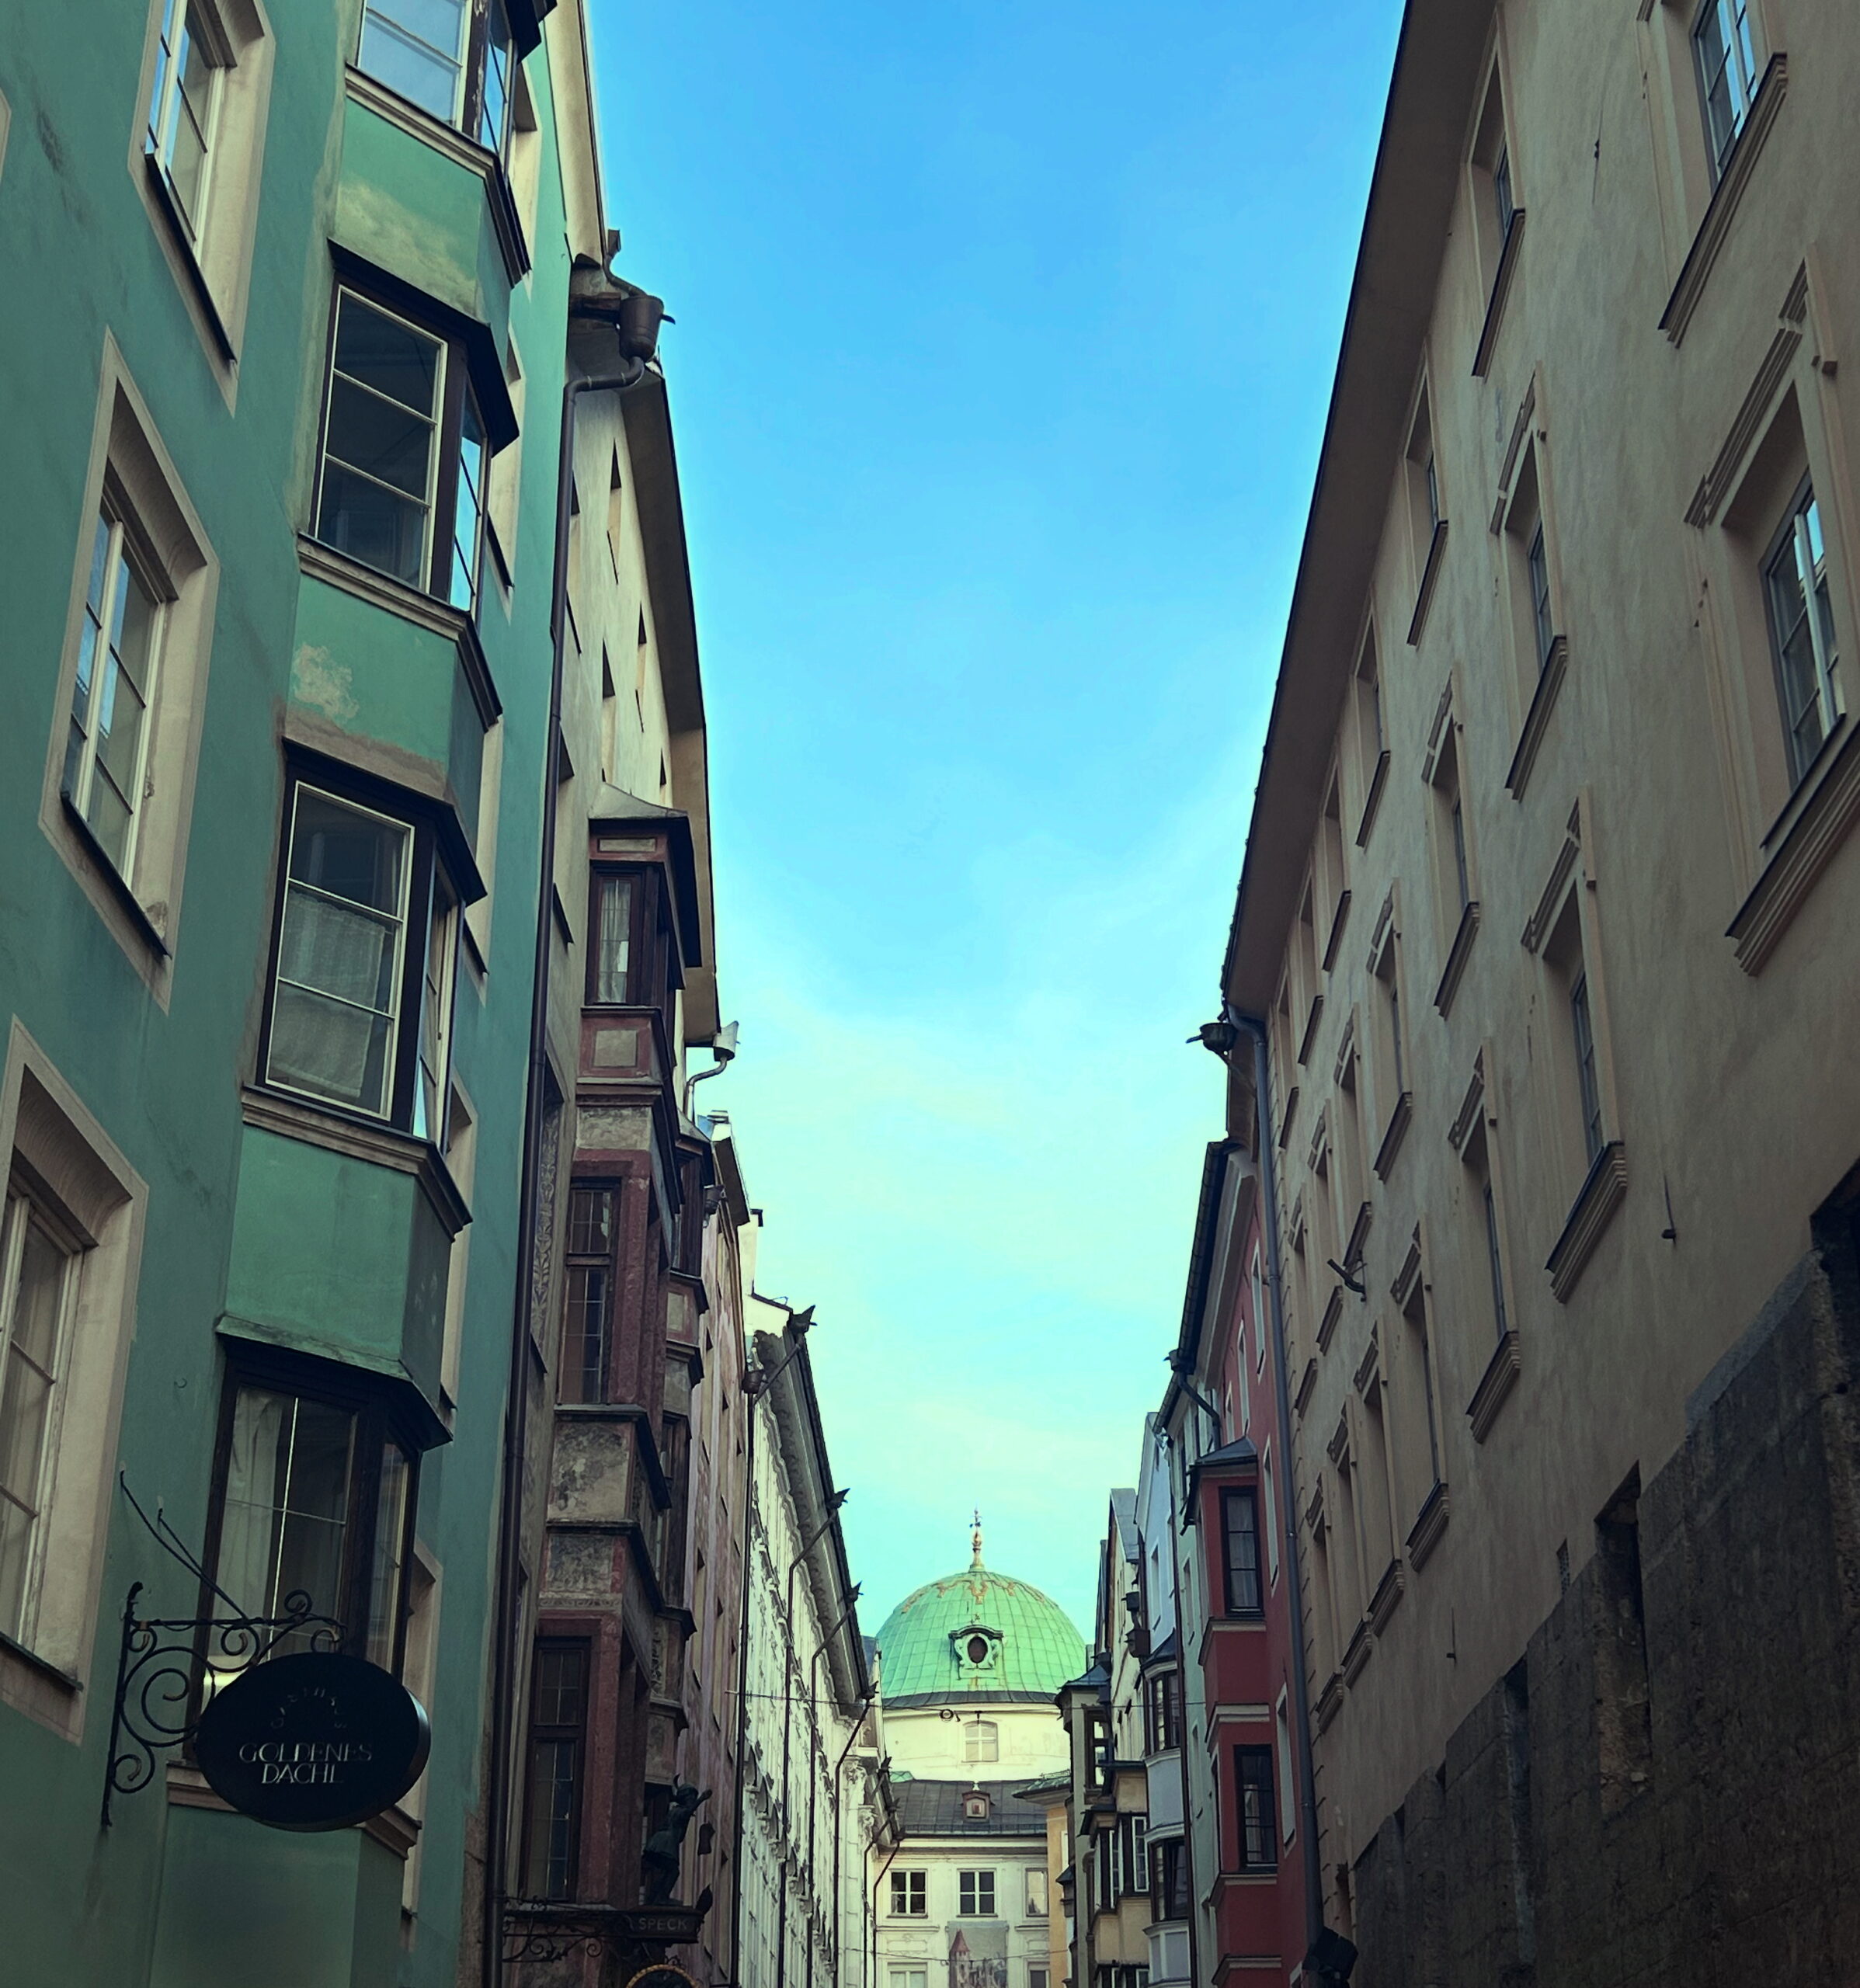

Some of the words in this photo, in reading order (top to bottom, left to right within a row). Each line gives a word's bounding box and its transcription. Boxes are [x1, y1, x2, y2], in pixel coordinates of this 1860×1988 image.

[238, 1743, 373, 1763] GOLDENES
[261, 1763, 344, 1784] DACHL
[638, 1917, 688, 1931] SPECK
